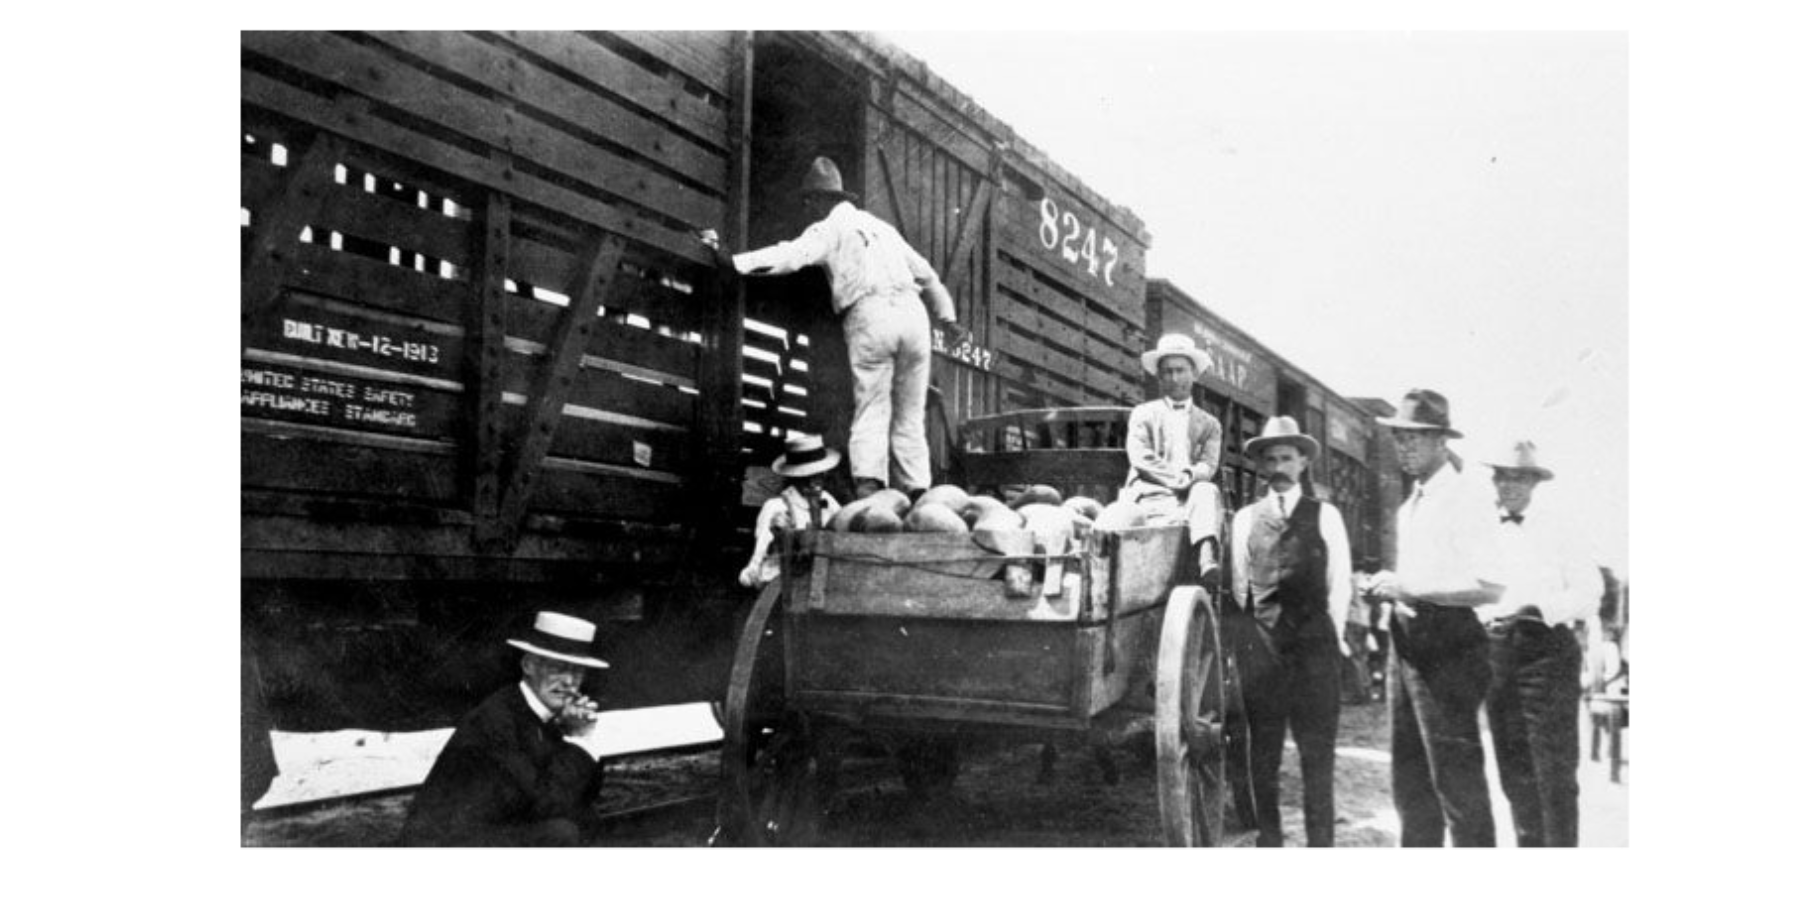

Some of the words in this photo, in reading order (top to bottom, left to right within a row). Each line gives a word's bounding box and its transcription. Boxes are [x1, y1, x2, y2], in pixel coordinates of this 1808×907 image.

[1039, 197, 1118, 287] 8247
[301, 376, 356, 399] STATES
[363, 386, 415, 407] SAFETY
[345, 403, 416, 427] STANDARD
